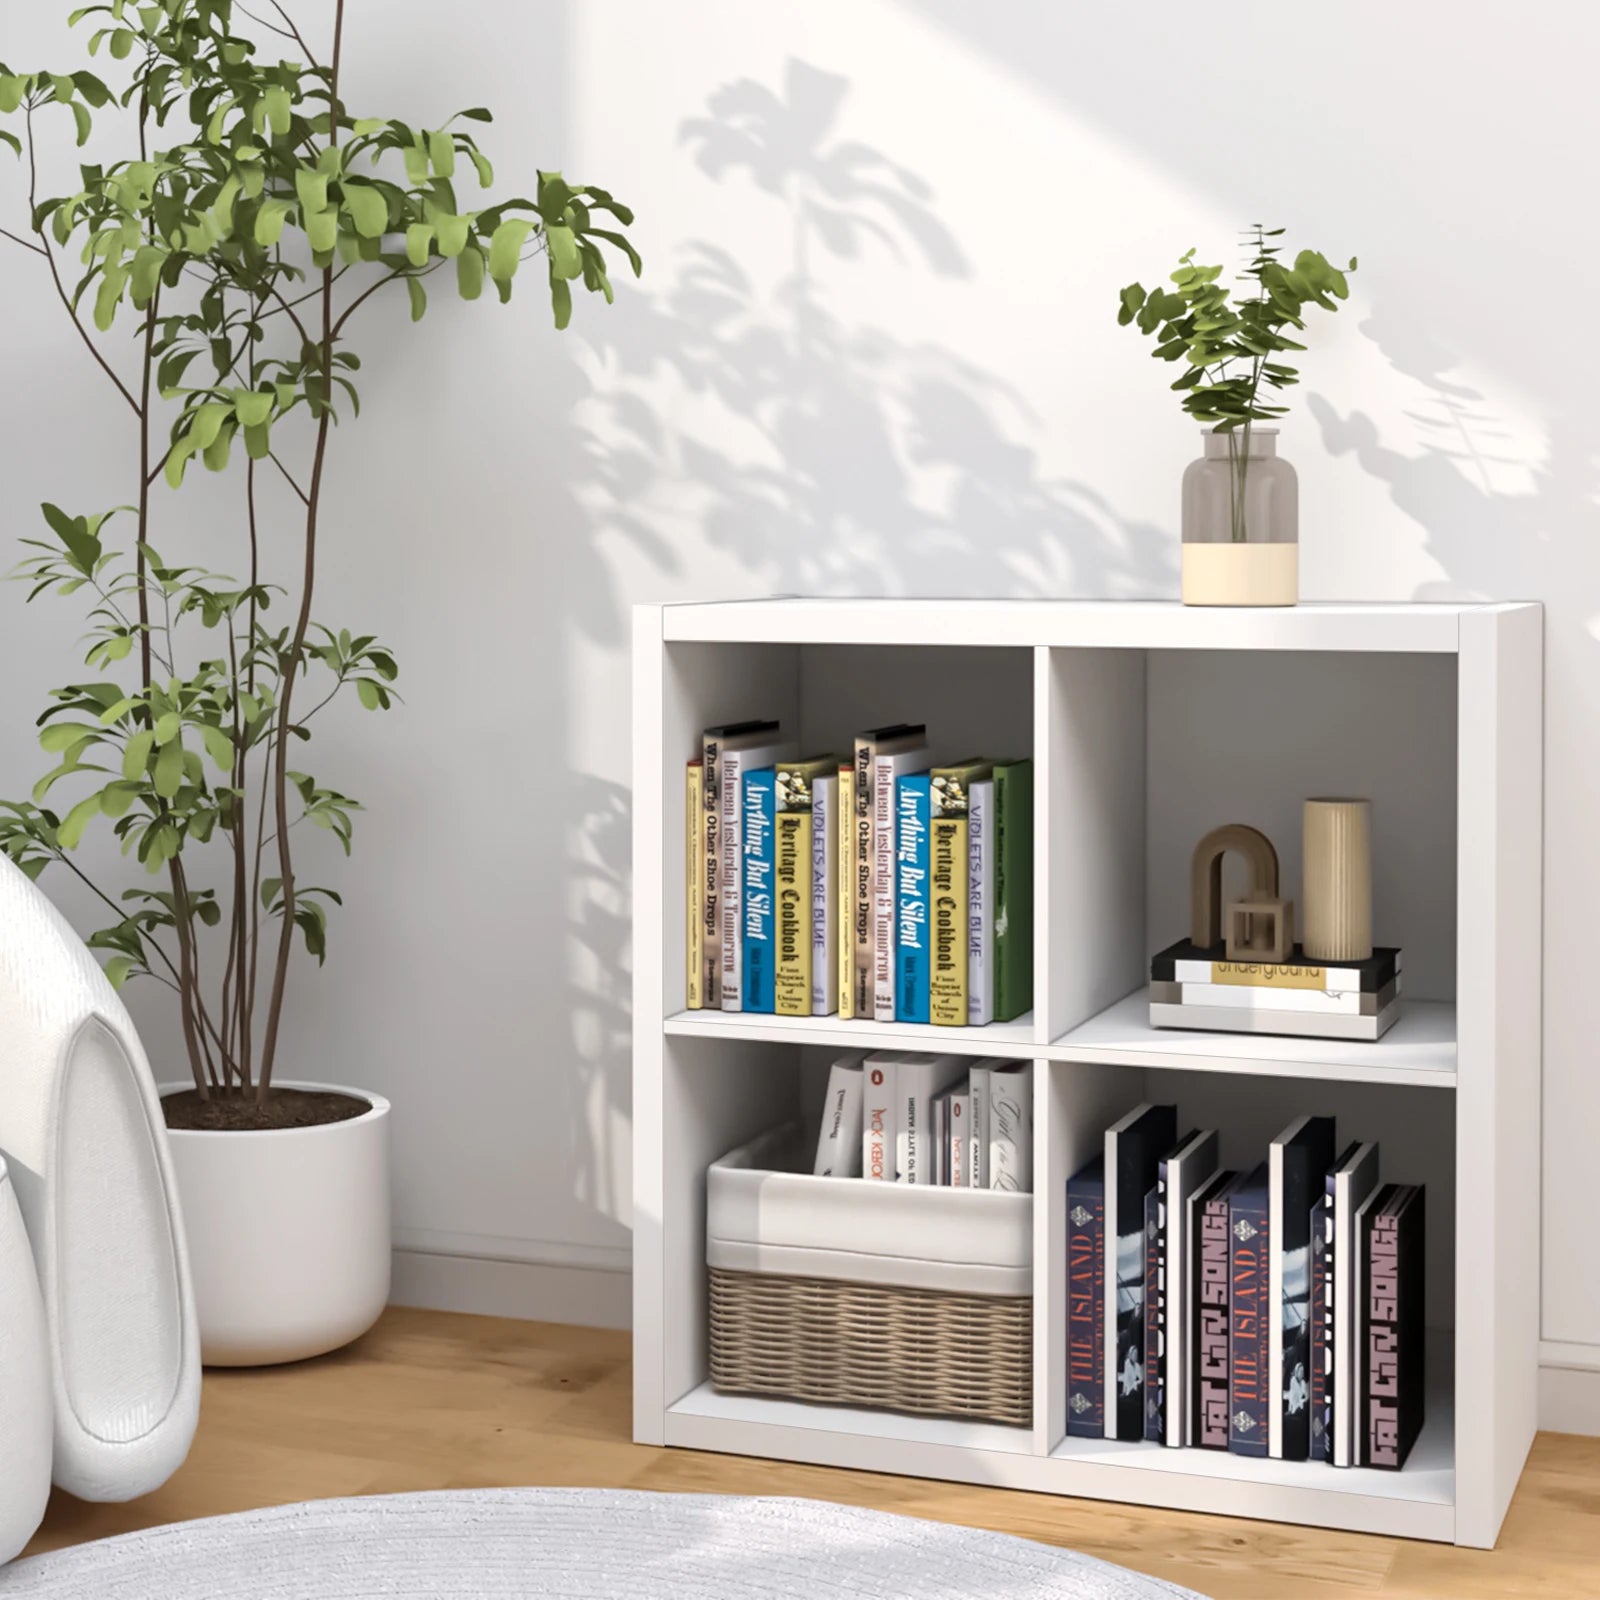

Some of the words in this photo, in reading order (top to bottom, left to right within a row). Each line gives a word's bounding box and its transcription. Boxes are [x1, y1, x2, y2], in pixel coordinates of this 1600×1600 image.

[706, 742, 718, 782] When
[858, 747, 870, 787] When
[706, 785, 718, 811] The
[723, 760, 738, 817] Between
[858, 791, 870, 817] The
[877, 765, 892, 821] Between
[706, 815, 718, 855] Other
[743, 780, 770, 855] Anything
[813, 800, 824, 868] VIOLETS
[858, 821, 870, 862] Other
[896, 785, 925, 863] Anything
[970, 805, 982, 873] VIOLETS
[706, 858, 718, 892] Shoe
[722, 820, 738, 887] Yesterday
[746, 858, 769, 888] But
[779, 817, 800, 884] Heritage
[875, 825, 892, 894] Yesterday
[934, 823, 957, 891] Heritage
[813, 870, 824, 903] ARE
[858, 865, 870, 899] Shoe
[899, 865, 925, 896] But
[970, 877, 982, 910] ARE
[705, 895, 717, 936] Drops
[723, 904, 738, 973] Tomorrow
[746, 890, 770, 940] Silent
[781, 889, 800, 962] Cookbook
[813, 910, 824, 949] BLUE
[857, 902, 869, 944] Drops
[899, 898, 925, 949] Silent
[936, 896, 957, 971] Cookbook
[970, 916, 982, 958] BLUE
[877, 911, 892, 983] Tomorrow
[1070, 1233, 1093, 1322] ISLAND
[1233, 1249, 1258, 1339] ISLAND
[1070, 1333, 1093, 1385] THE
[1233, 1350, 1258, 1403] THE
